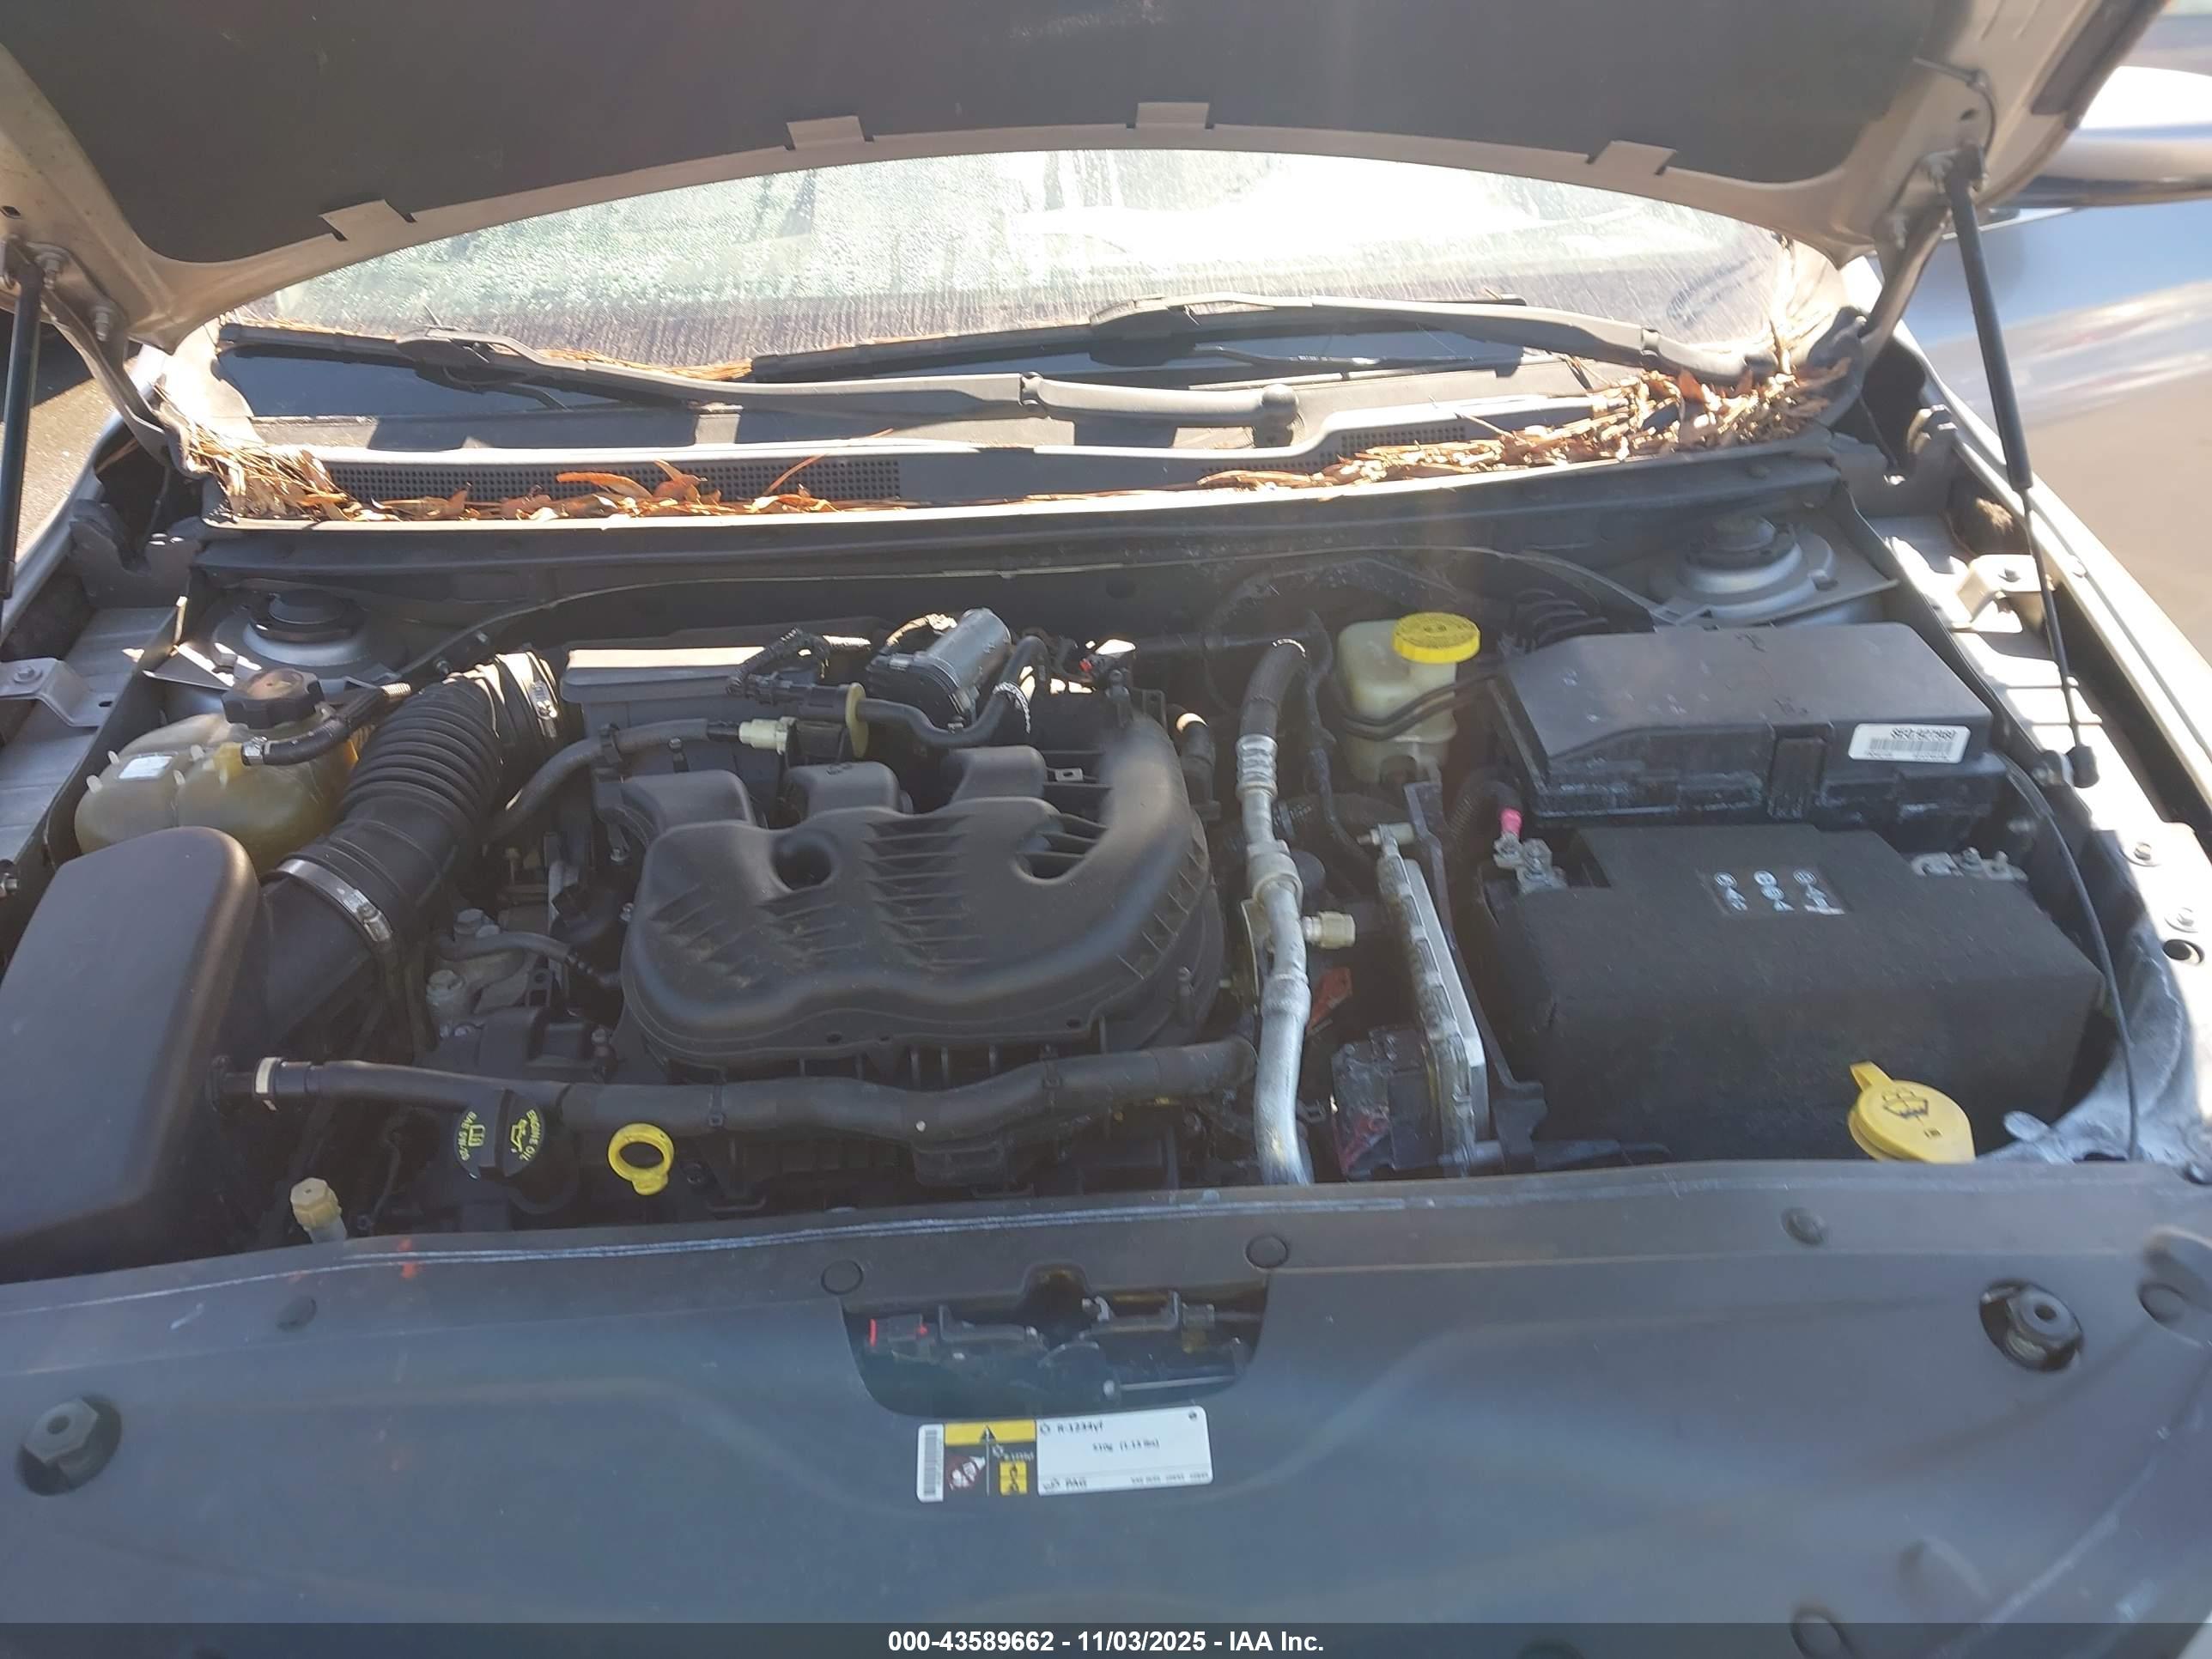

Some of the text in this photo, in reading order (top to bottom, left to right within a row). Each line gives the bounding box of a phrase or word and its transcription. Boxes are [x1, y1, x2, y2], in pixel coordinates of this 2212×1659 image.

[461, 1111, 477, 1130] SAE
[520, 1109, 540, 1161] ENGINE OIL
